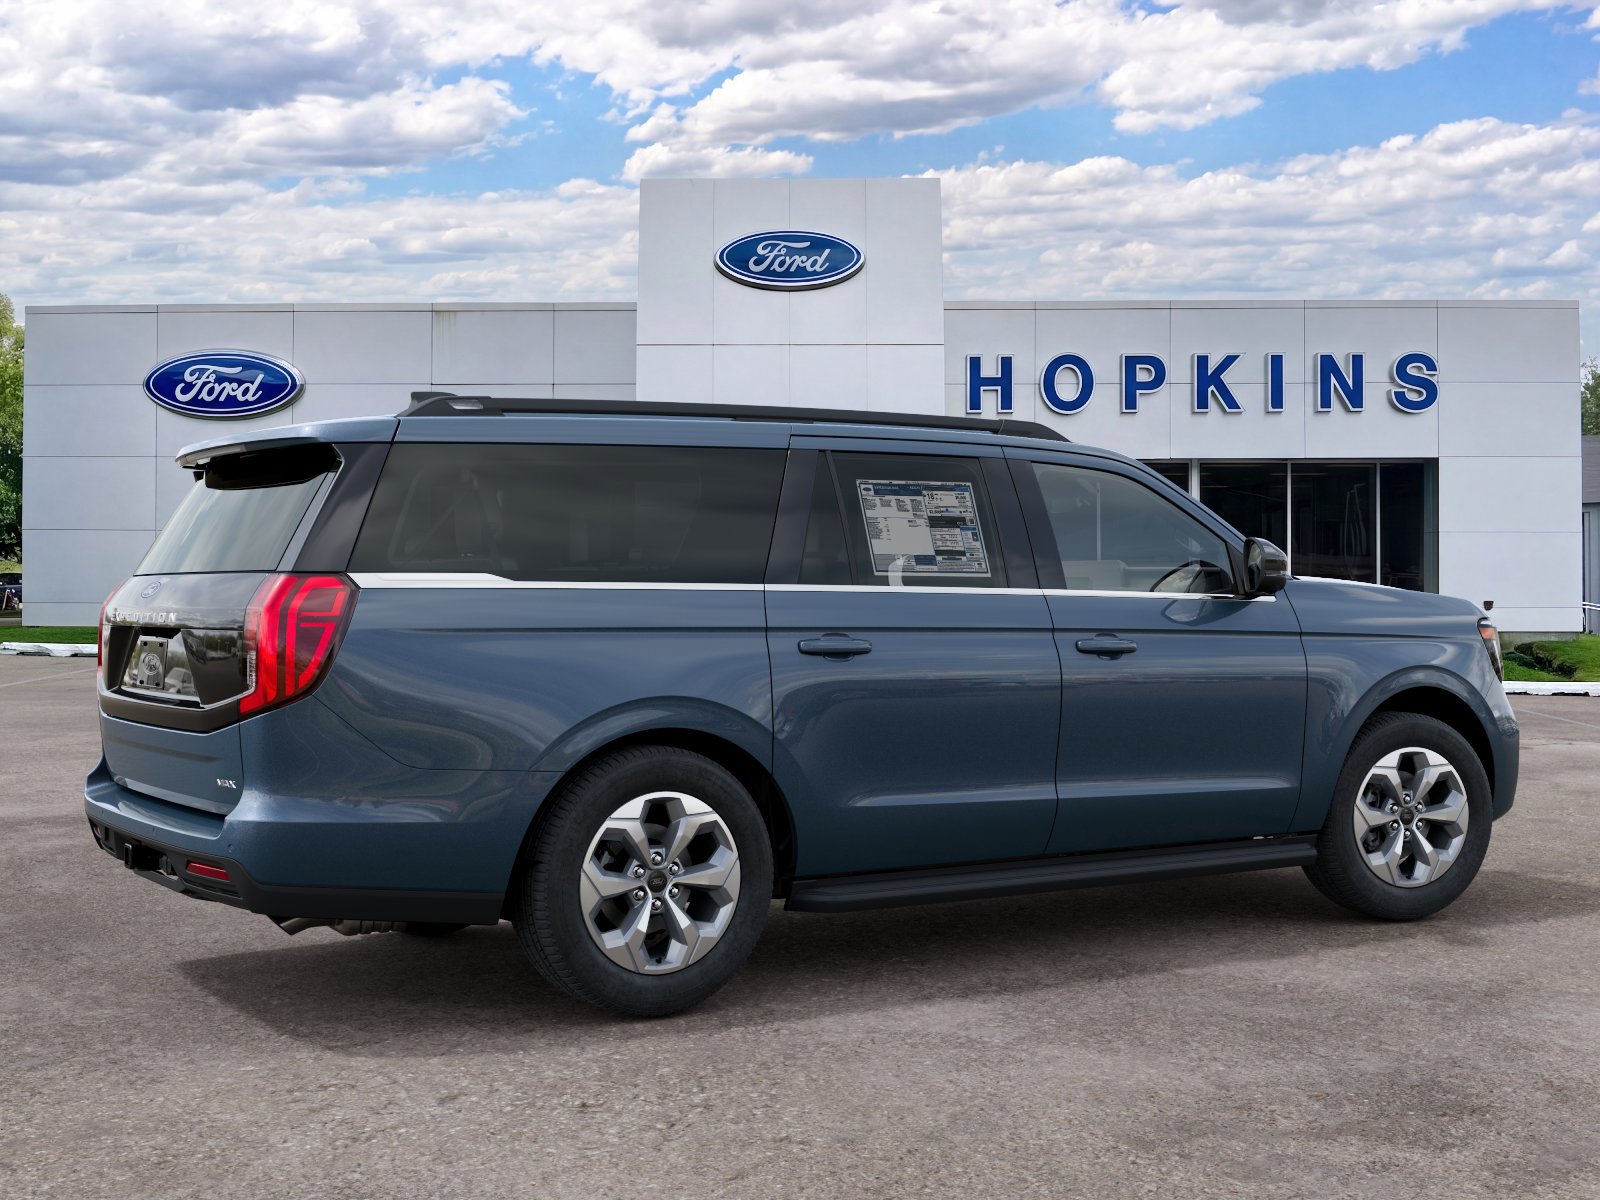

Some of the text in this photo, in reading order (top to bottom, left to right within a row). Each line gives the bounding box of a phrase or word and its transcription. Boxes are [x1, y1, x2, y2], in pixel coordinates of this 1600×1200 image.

[748, 240, 831, 273] Ford
[174, 364, 265, 402] Ford
[965, 351, 1440, 414] HOPKINS
